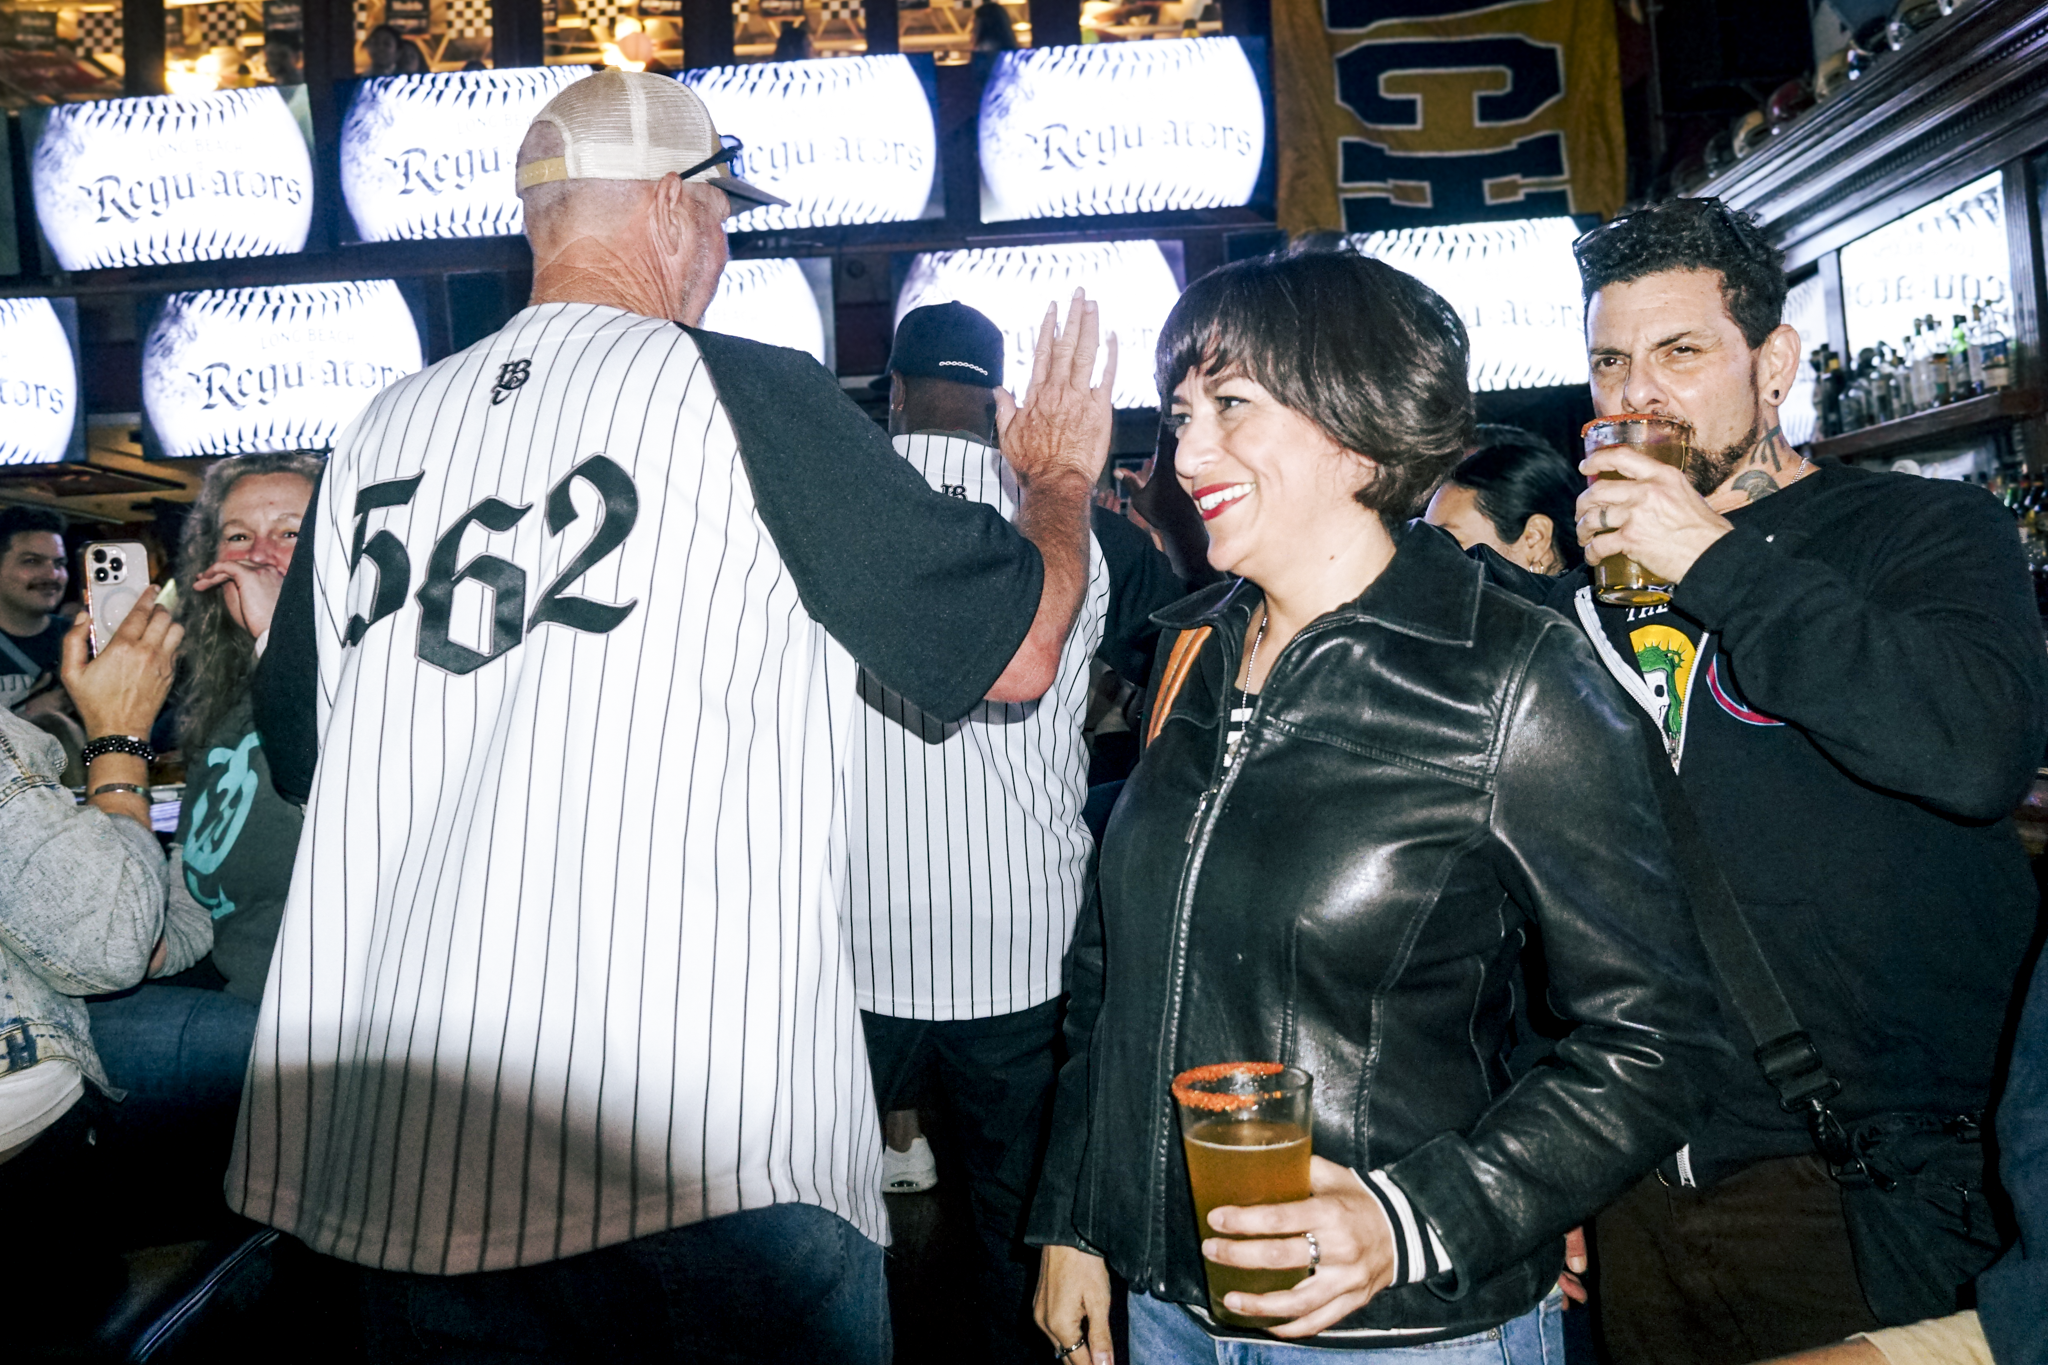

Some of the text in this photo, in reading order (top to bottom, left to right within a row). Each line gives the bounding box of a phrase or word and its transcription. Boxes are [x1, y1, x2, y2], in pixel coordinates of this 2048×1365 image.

[1024, 119, 1252, 173] Reguators
[1322, 0, 1576, 234] CH
[341, 451, 639, 677] 562
